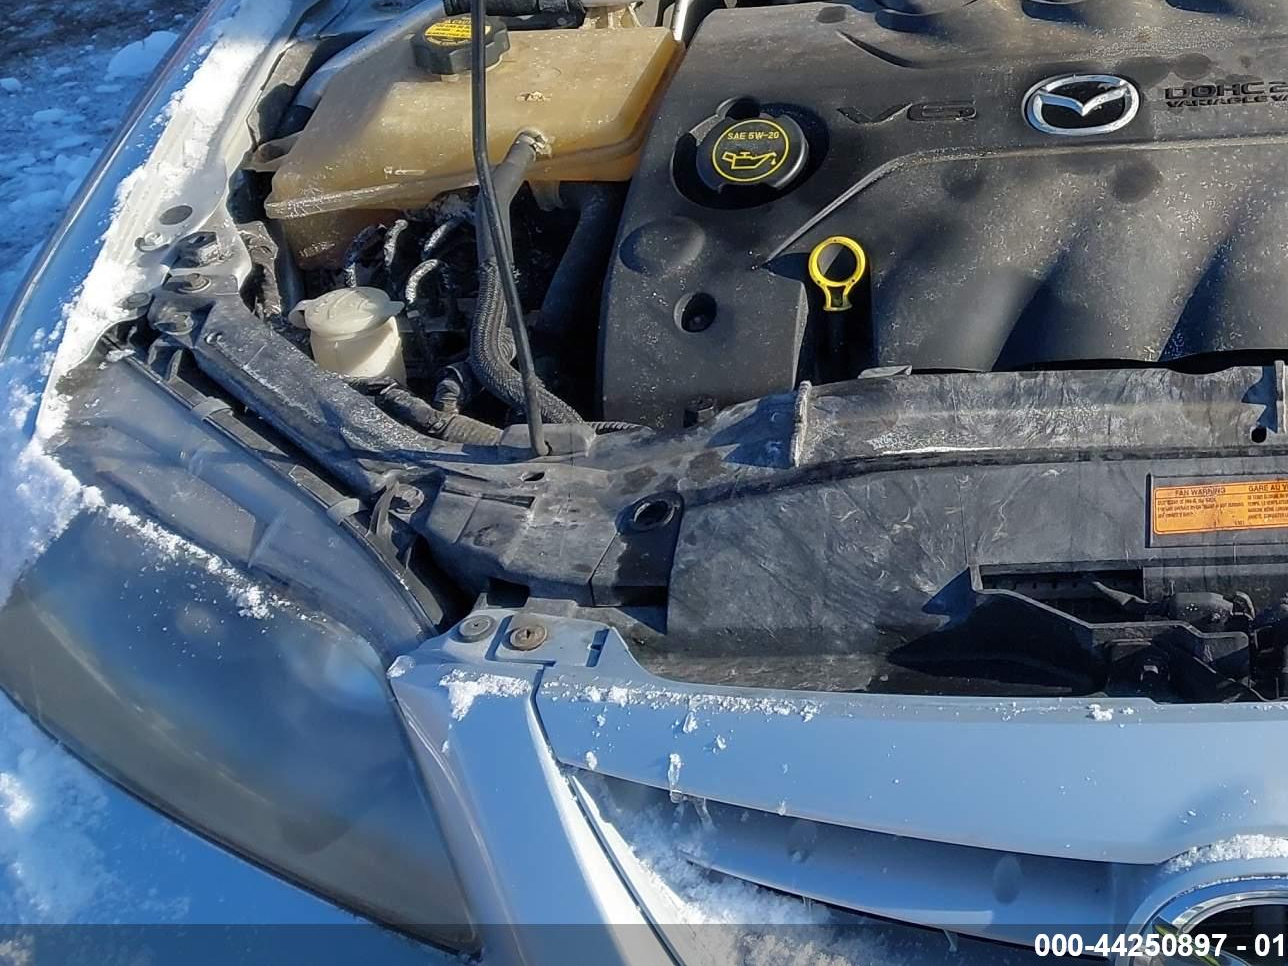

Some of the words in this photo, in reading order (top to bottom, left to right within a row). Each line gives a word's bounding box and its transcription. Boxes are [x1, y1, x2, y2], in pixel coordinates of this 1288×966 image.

[1165, 81, 1264, 99] DOHC
[836, 101, 978, 125] V6
[727, 132, 746, 140] SAE
[748, 131, 780, 140] 5W-20
[1191, 487, 1226, 496] WARNING
[1248, 484, 1269, 492] GARE
[1270, 483, 1281, 491] AU
